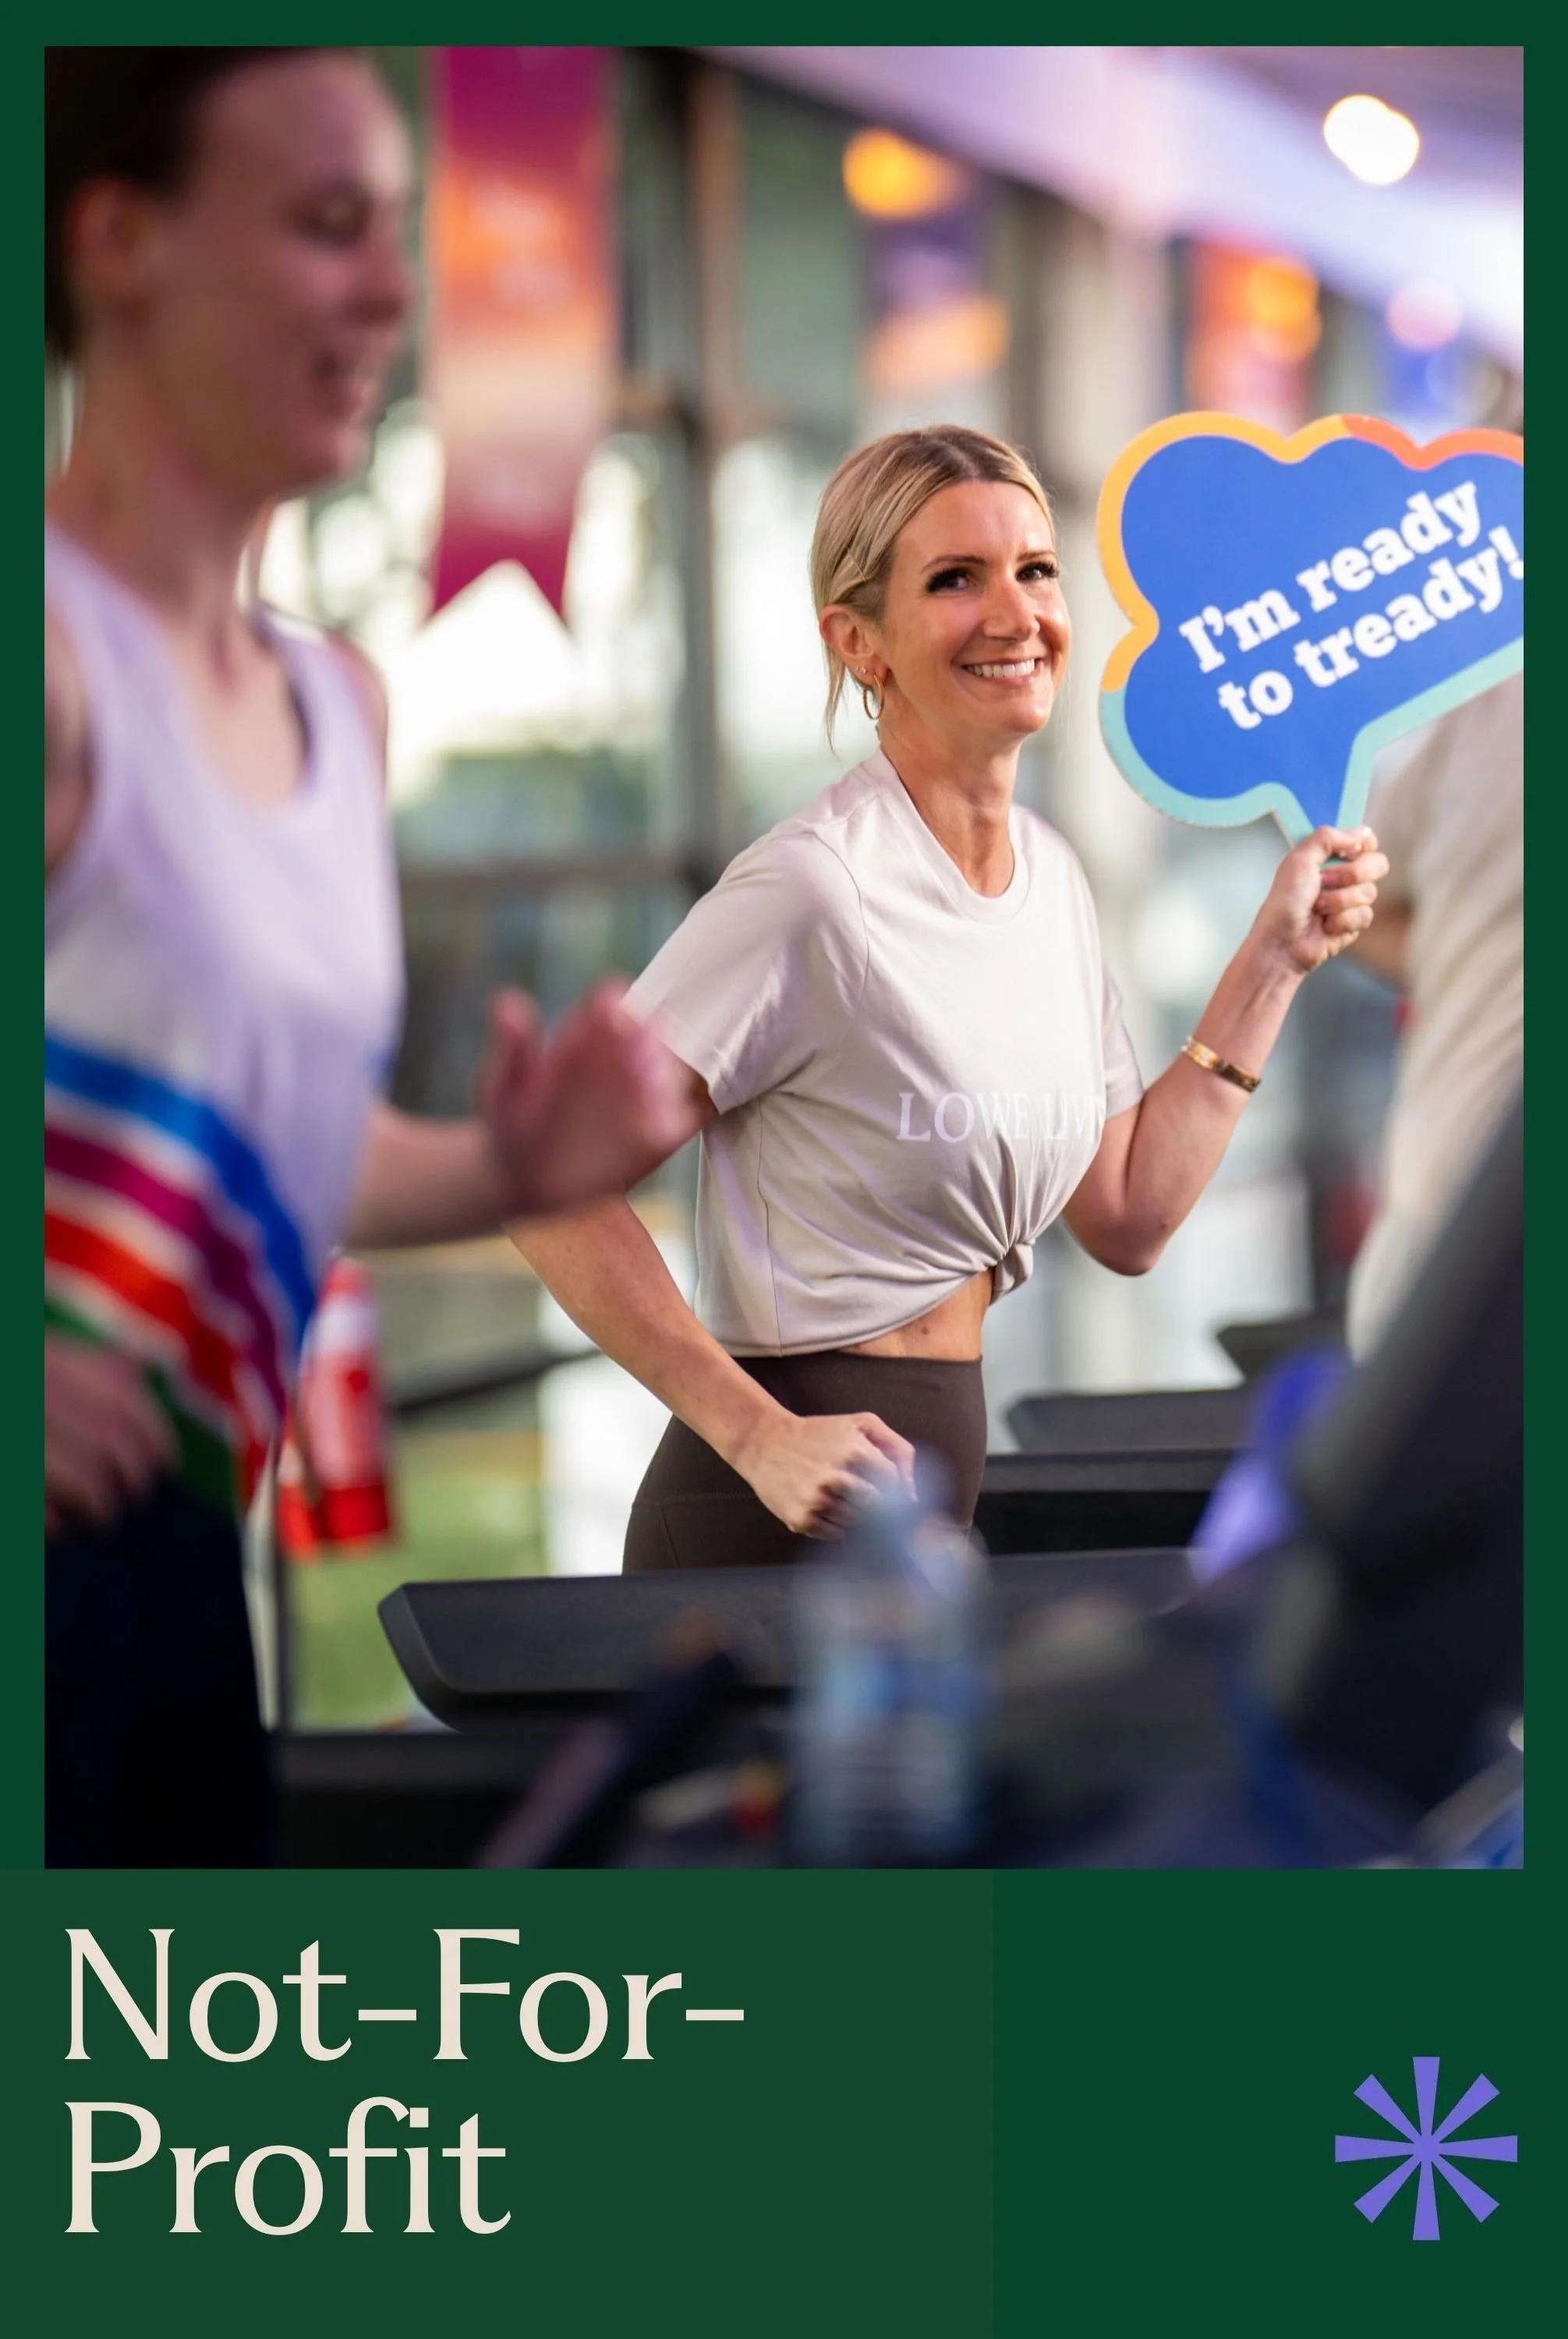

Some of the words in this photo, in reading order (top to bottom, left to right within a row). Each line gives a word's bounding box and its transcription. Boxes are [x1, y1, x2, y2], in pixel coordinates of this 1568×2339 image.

[1178, 589, 1301, 674] I’m
[1295, 480, 1481, 612] ready
[1217, 670, 1294, 730] to
[1293, 525, 1524, 688] tready!
